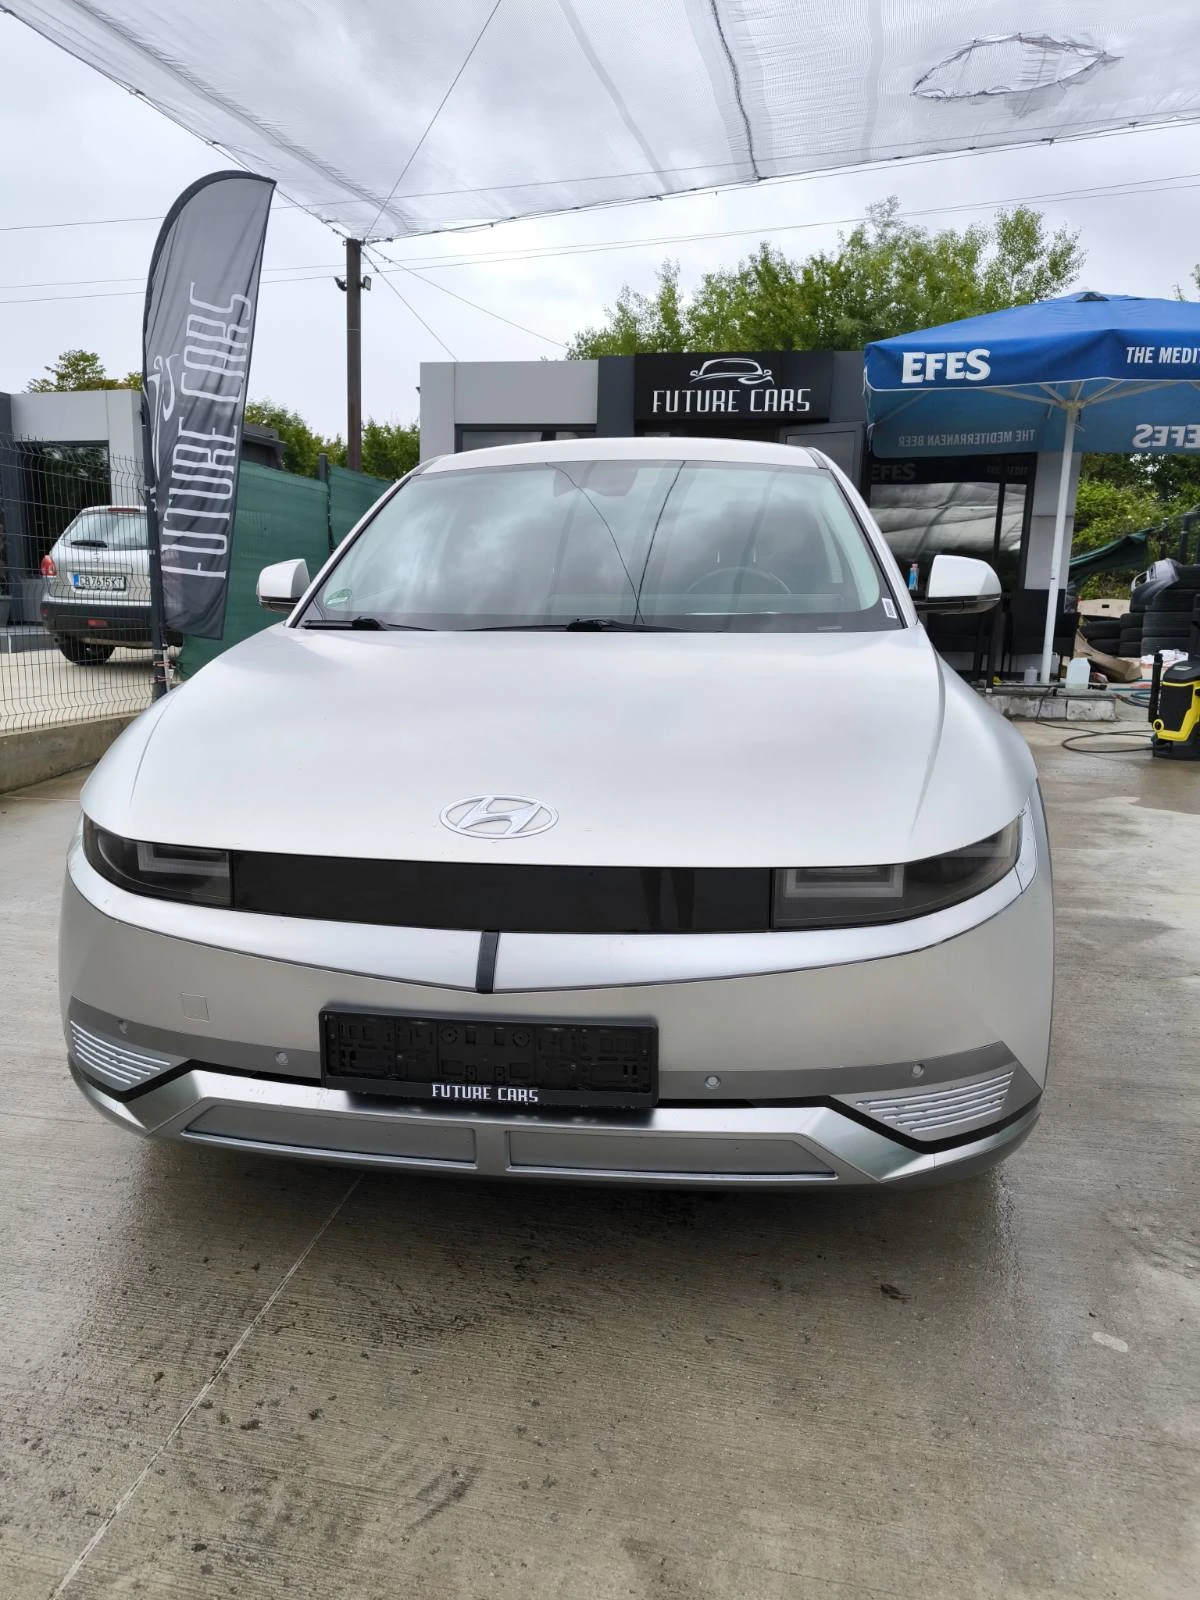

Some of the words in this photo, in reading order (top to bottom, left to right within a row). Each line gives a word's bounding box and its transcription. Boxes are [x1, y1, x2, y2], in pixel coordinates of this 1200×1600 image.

[180, 282, 251, 403] CARS
[1126, 346, 1155, 364] THE
[901, 348, 991, 384] EFES
[652, 389, 742, 414] FUTURE
[749, 388, 812, 413] CARS
[160, 416, 239, 580] FUTURE
[431, 1083, 492, 1100] FUTURE
[497, 1087, 539, 1102] CARS
